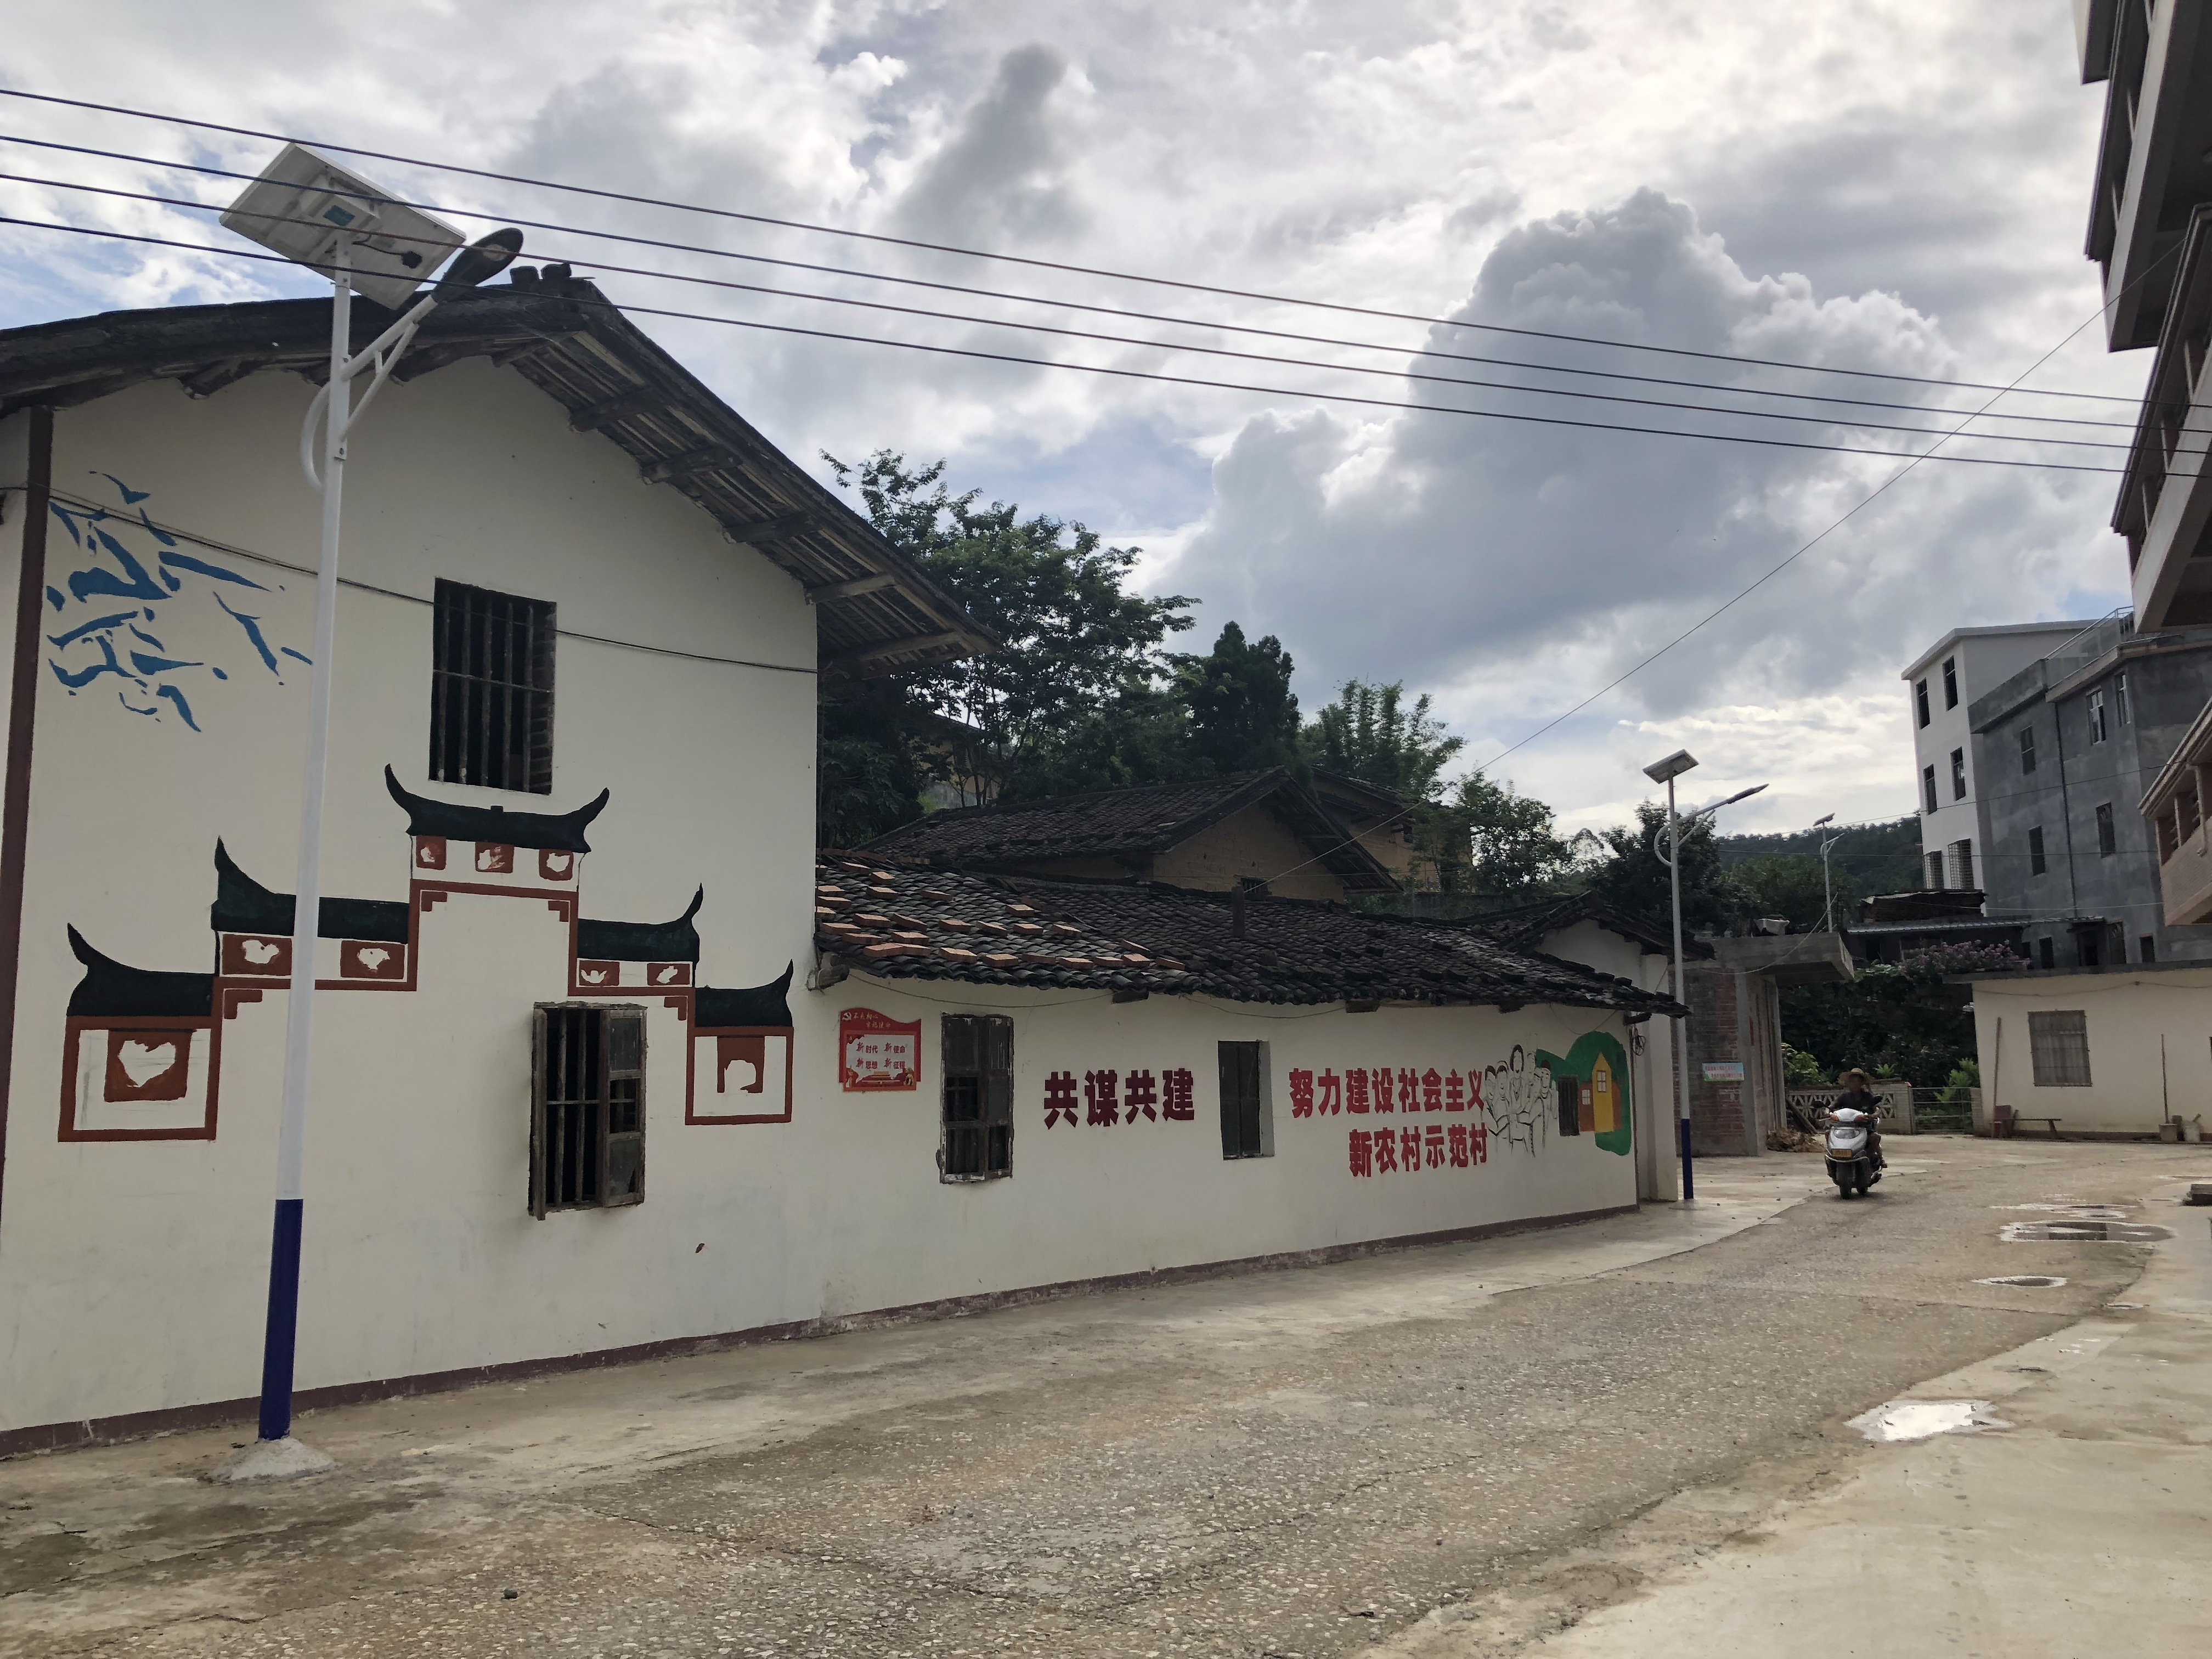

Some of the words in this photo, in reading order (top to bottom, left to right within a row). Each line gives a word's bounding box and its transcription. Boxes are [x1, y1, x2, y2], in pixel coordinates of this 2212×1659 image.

[855, 1058, 878, 1069] 新思想
[883, 1058, 905, 1069] 新征程
[856, 1042, 878, 1054] 新时代
[884, 1042, 906, 1054] 新使命
[1044, 1068, 1194, 1130] 共谋共建
[1289, 1068, 1485, 1118] 努力建设社会主义
[1349, 1122, 1487, 1177] 新农村示范村
